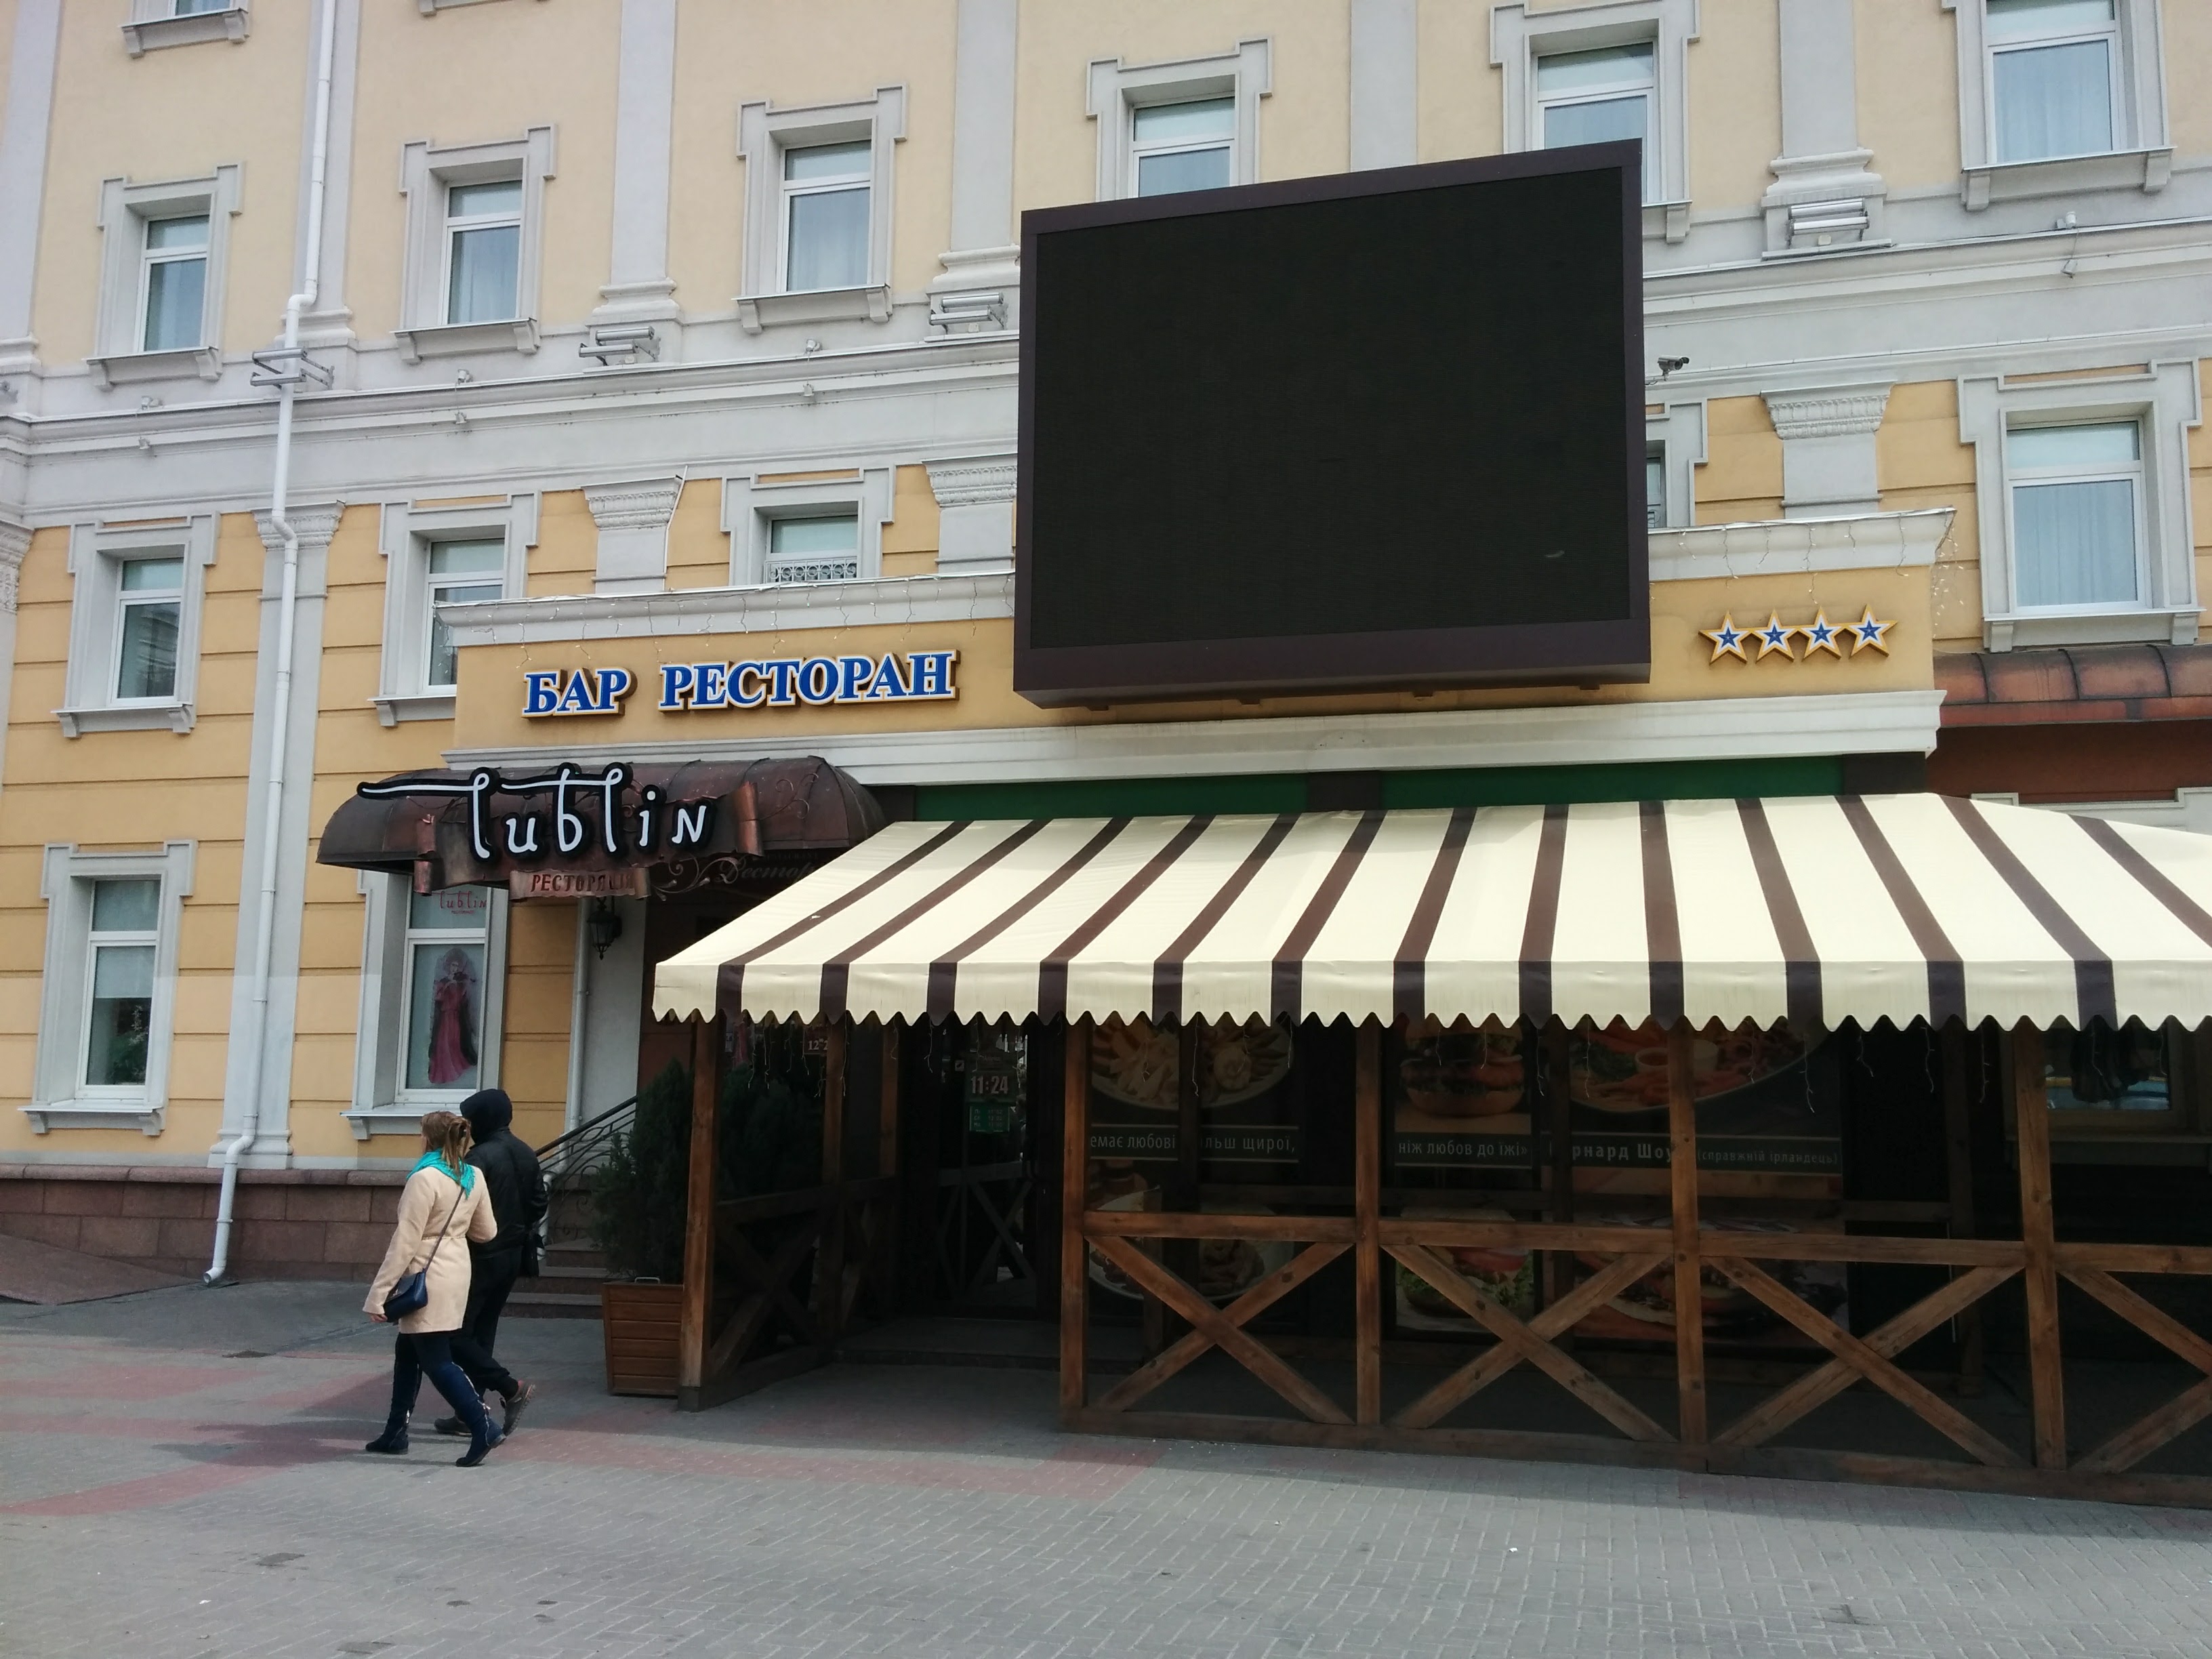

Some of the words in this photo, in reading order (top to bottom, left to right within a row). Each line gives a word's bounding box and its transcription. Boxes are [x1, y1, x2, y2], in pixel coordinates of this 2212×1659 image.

[522, 667, 634, 718] БАР
[657, 649, 958, 712] РЕСТОРАН
[970, 1076, 1009, 1094] 11:24
[1127, 1132, 1176, 1149] любові
[1242, 1135, 1295, 1153] щирої,
[1398, 1140, 1422, 1154] ніж
[1427, 1139, 1472, 1155] любов
[1477, 1143, 1494, 1158] до
